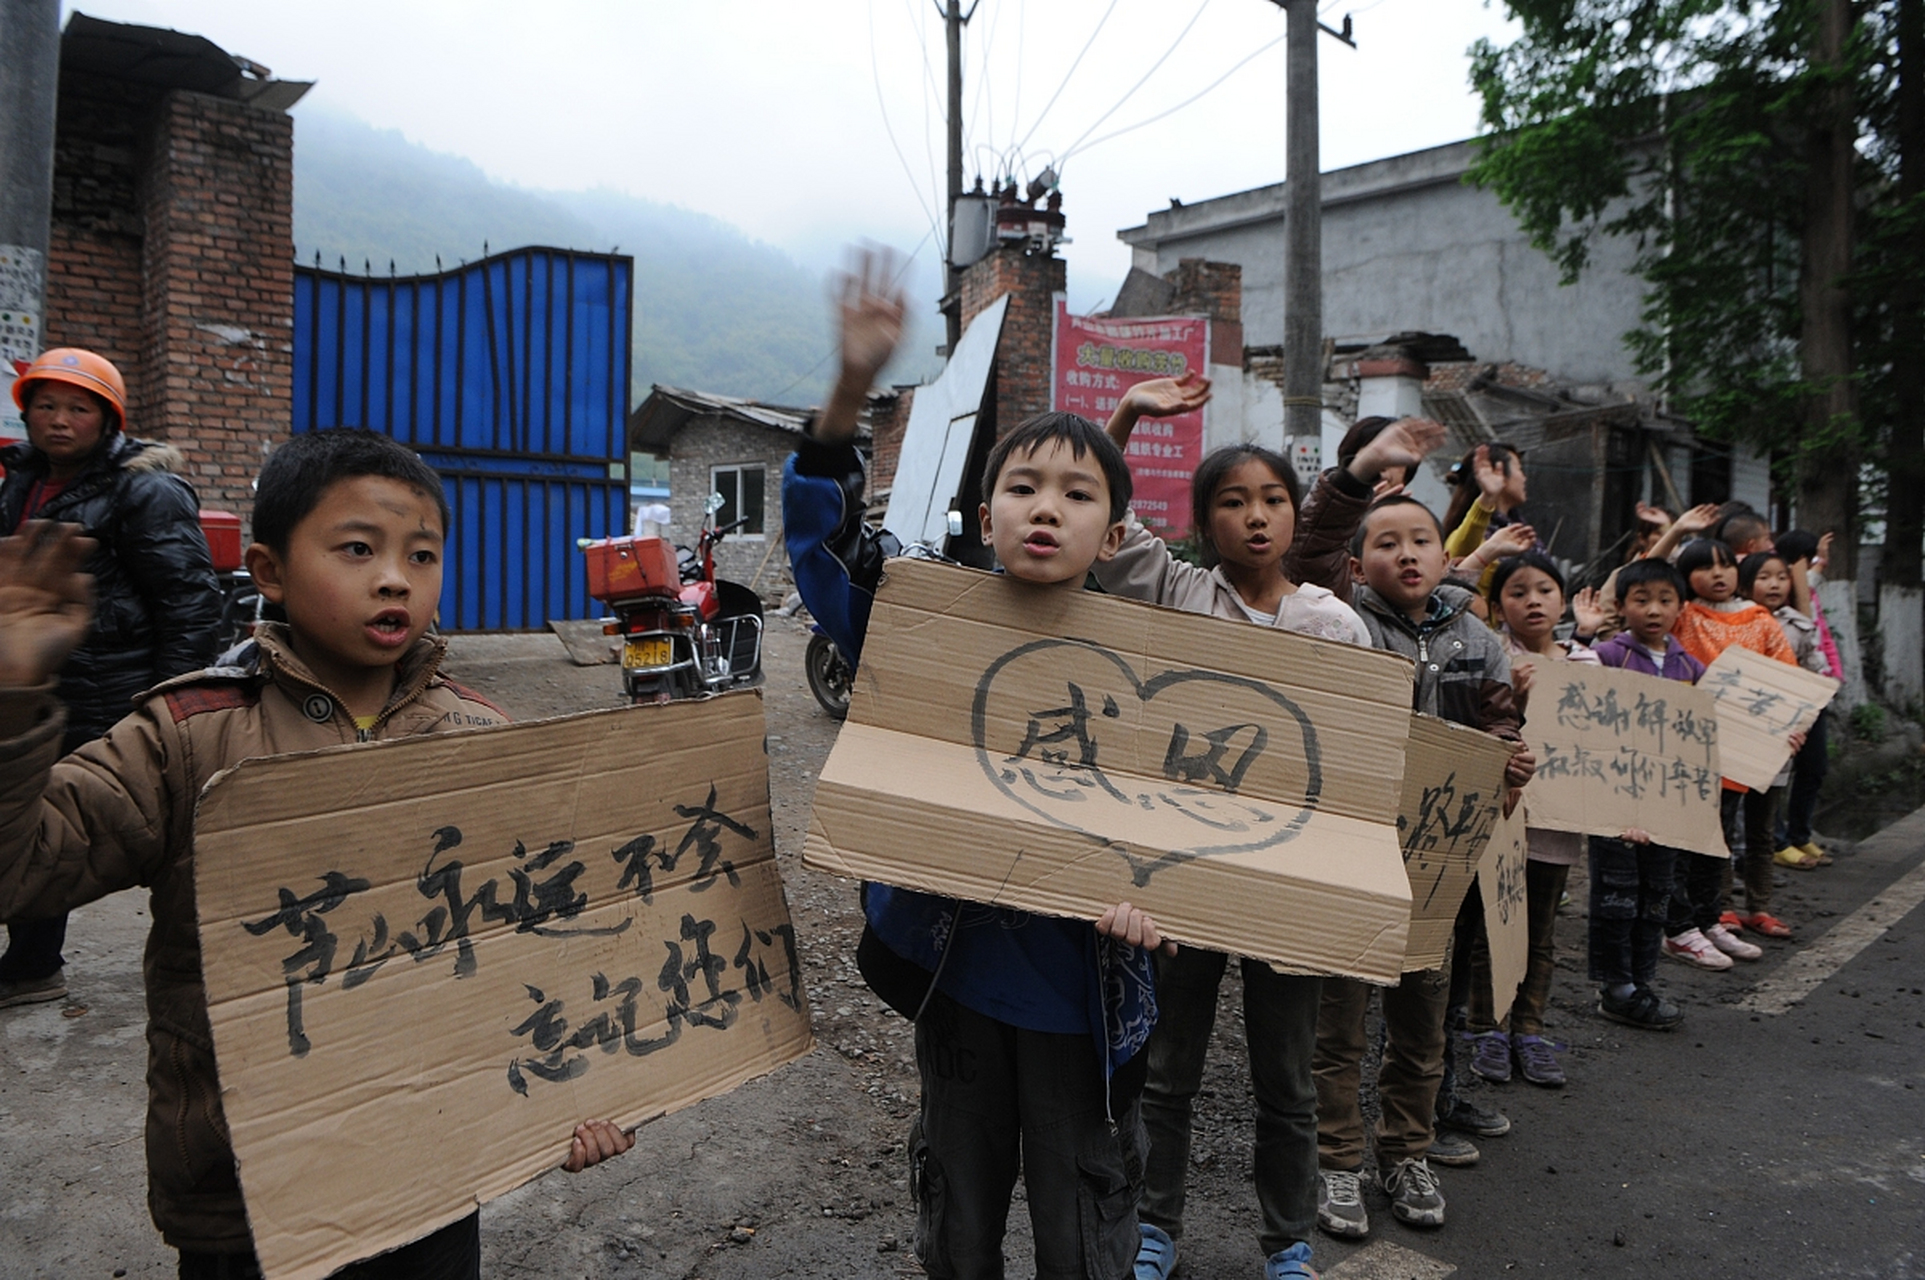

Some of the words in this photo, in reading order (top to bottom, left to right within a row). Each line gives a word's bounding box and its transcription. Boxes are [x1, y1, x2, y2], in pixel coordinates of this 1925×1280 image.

[1001, 681, 1274, 832] 感恩
[1557, 681, 1717, 770] 感谢解放军
[1397, 771, 1500, 911] 路平安
